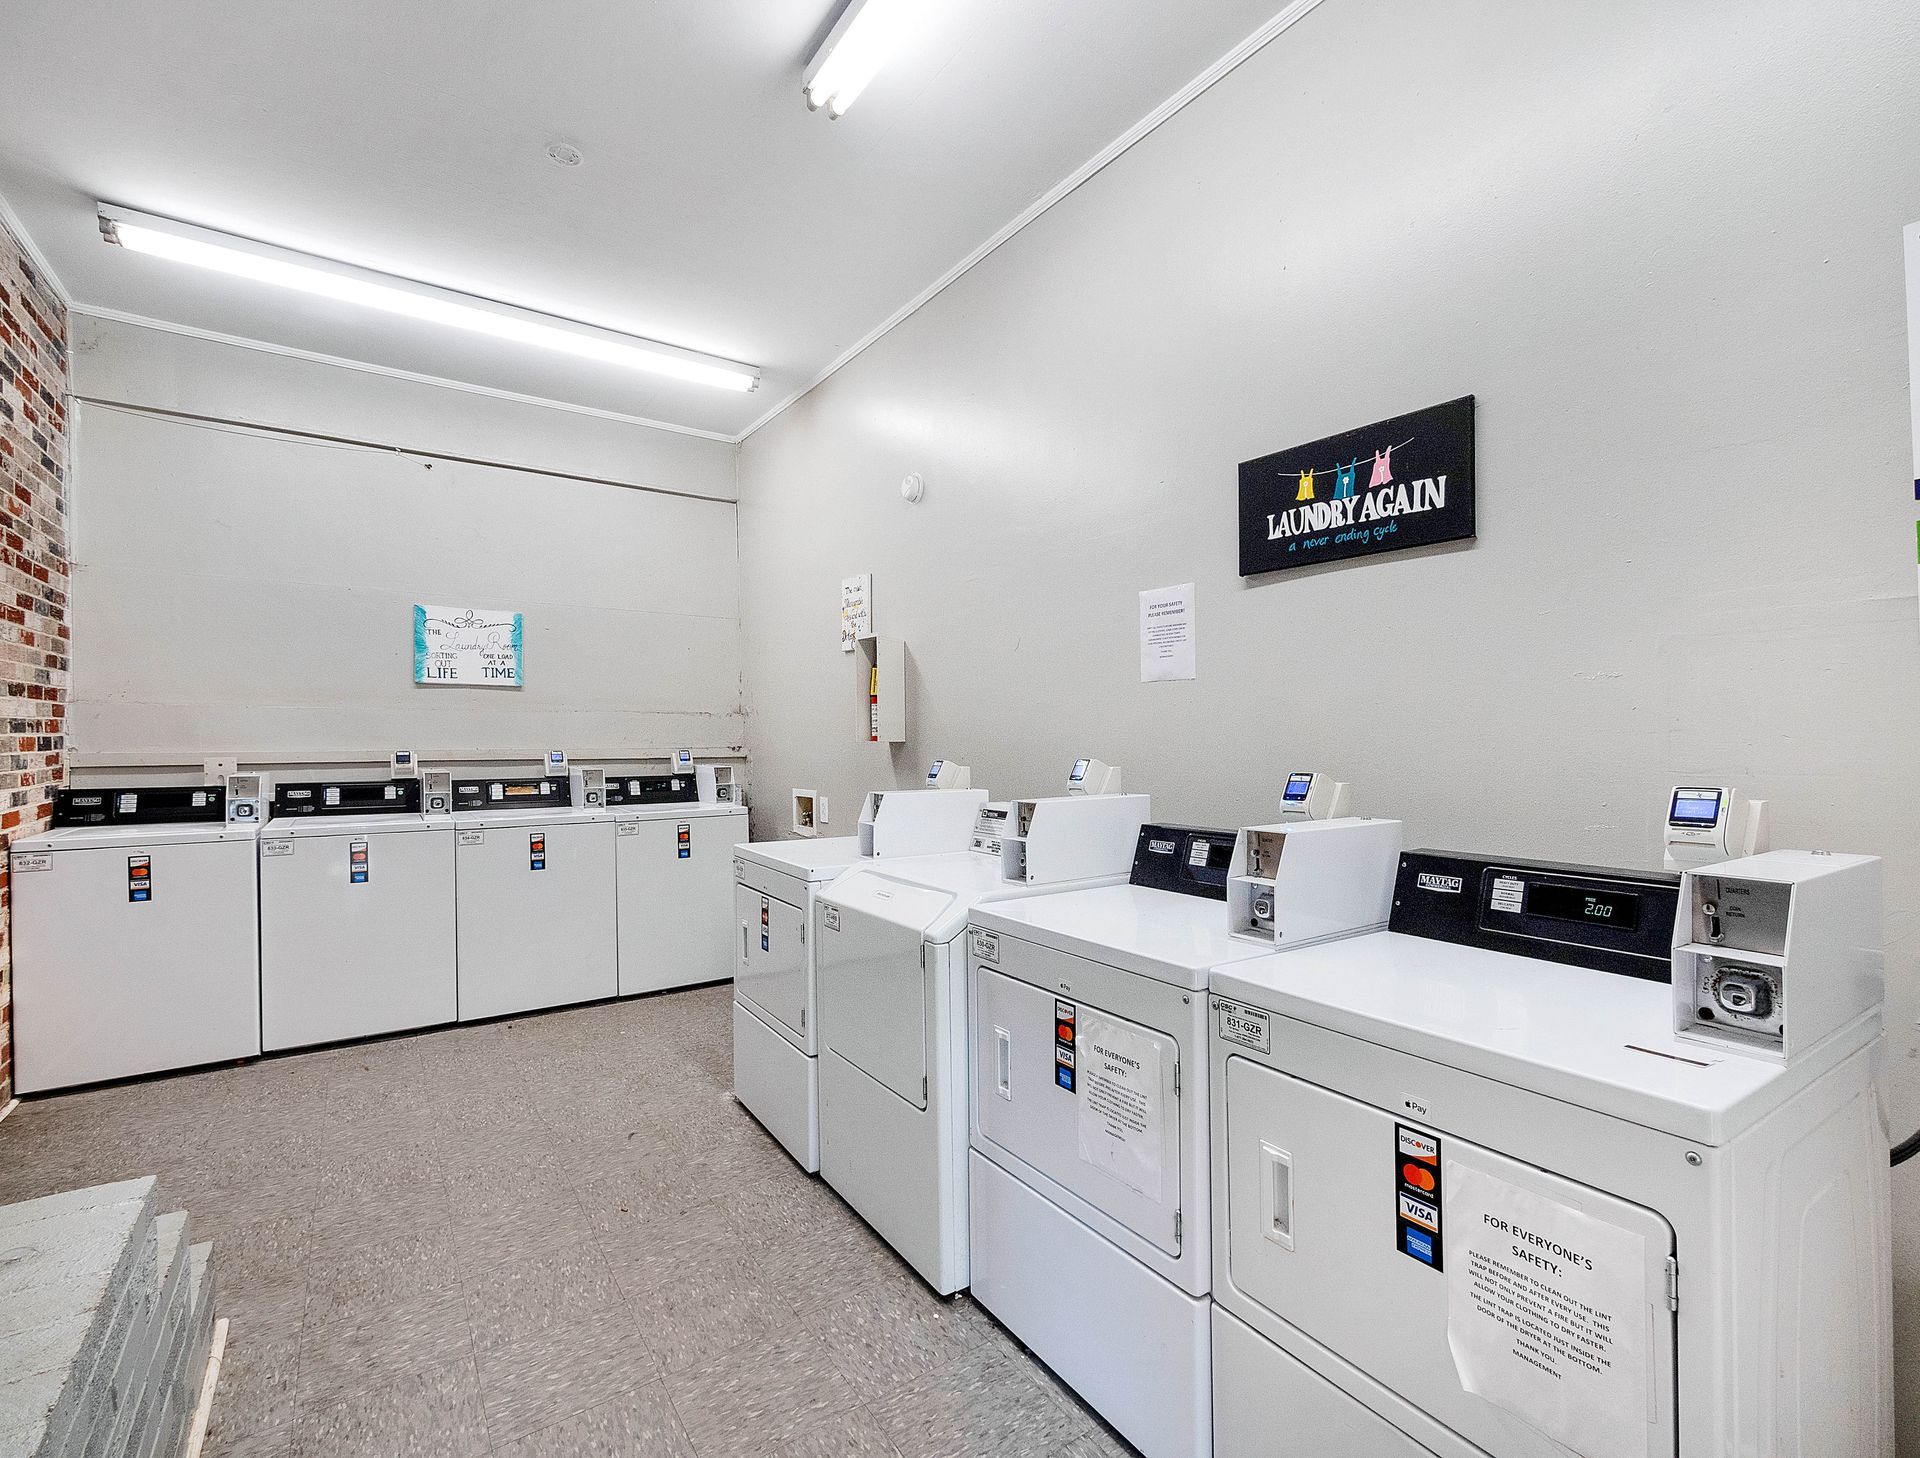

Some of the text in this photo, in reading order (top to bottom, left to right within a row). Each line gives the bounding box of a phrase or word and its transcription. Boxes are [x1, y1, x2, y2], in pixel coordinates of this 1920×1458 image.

[1267, 475, 1447, 540] LAUNDRY AGAIN
[1288, 520, 1398, 552] a never ending cycle
[425, 652, 458, 660] SORTING
[440, 631, 485, 657] Laundry
[427, 667, 458, 679] LIFE
[434, 660, 452, 668] OUT
[481, 667, 516, 679] TIME
[1420, 875, 1459, 888] MAYTAG
[1725, 887, 1750, 895] QUARTERS
[1584, 903, 1613, 917] 2.00
[1226, 1016, 1263, 1036] 831-GZR
[1059, 1050, 1072, 1062] VISA
[1093, 1044, 1141, 1070] FOR EVERYONE'S
[1104, 1062, 1127, 1078] SAFETY:
[1411, 1101, 1427, 1115] Pay
[1400, 1134, 1436, 1154] DISCOVER
[1404, 1182, 1434, 1199] mastercard
[1404, 1200, 1434, 1223] VISA
[1483, 1213, 1593, 1271] FOR EVERYONE'S
[1511, 1245, 1562, 1278] SAFETY:
[1469, 1250, 1613, 1322] PLEASE REMEMBER TO CLEAN OUT THE LINT
[1471, 1260, 1610, 1333] TRAP BEFORE AND AFTER EVERY USE. THIS
[1468, 1268, 1484, 1281] WILL
[1484, 1276, 1498, 1287] NOT
[1499, 1284, 1516, 1297] ONLY
[1517, 1293, 1546, 1312] PREVENT
[1554, 1312, 1568, 1324] FIRE
[1570, 1320, 1584, 1331] BUT
[1585, 1328, 1593, 1336] IT
[1594, 1332, 1613, 1345] WILL
[1473, 1281, 1607, 1353] ALLOW YOUR CLOTHING TO DRY FASTER.
[1469, 1292, 1611, 1368] THE LINT TRAP IS LOCATED JUST INSIDE THE
[1476, 1304, 1603, 1375] DOOR OF THE DRYER AT THE BOTTOM.
[1516, 1338, 1557, 1365] THANK YOU.
[1512, 1348, 1562, 1380] MANAGEMENT
